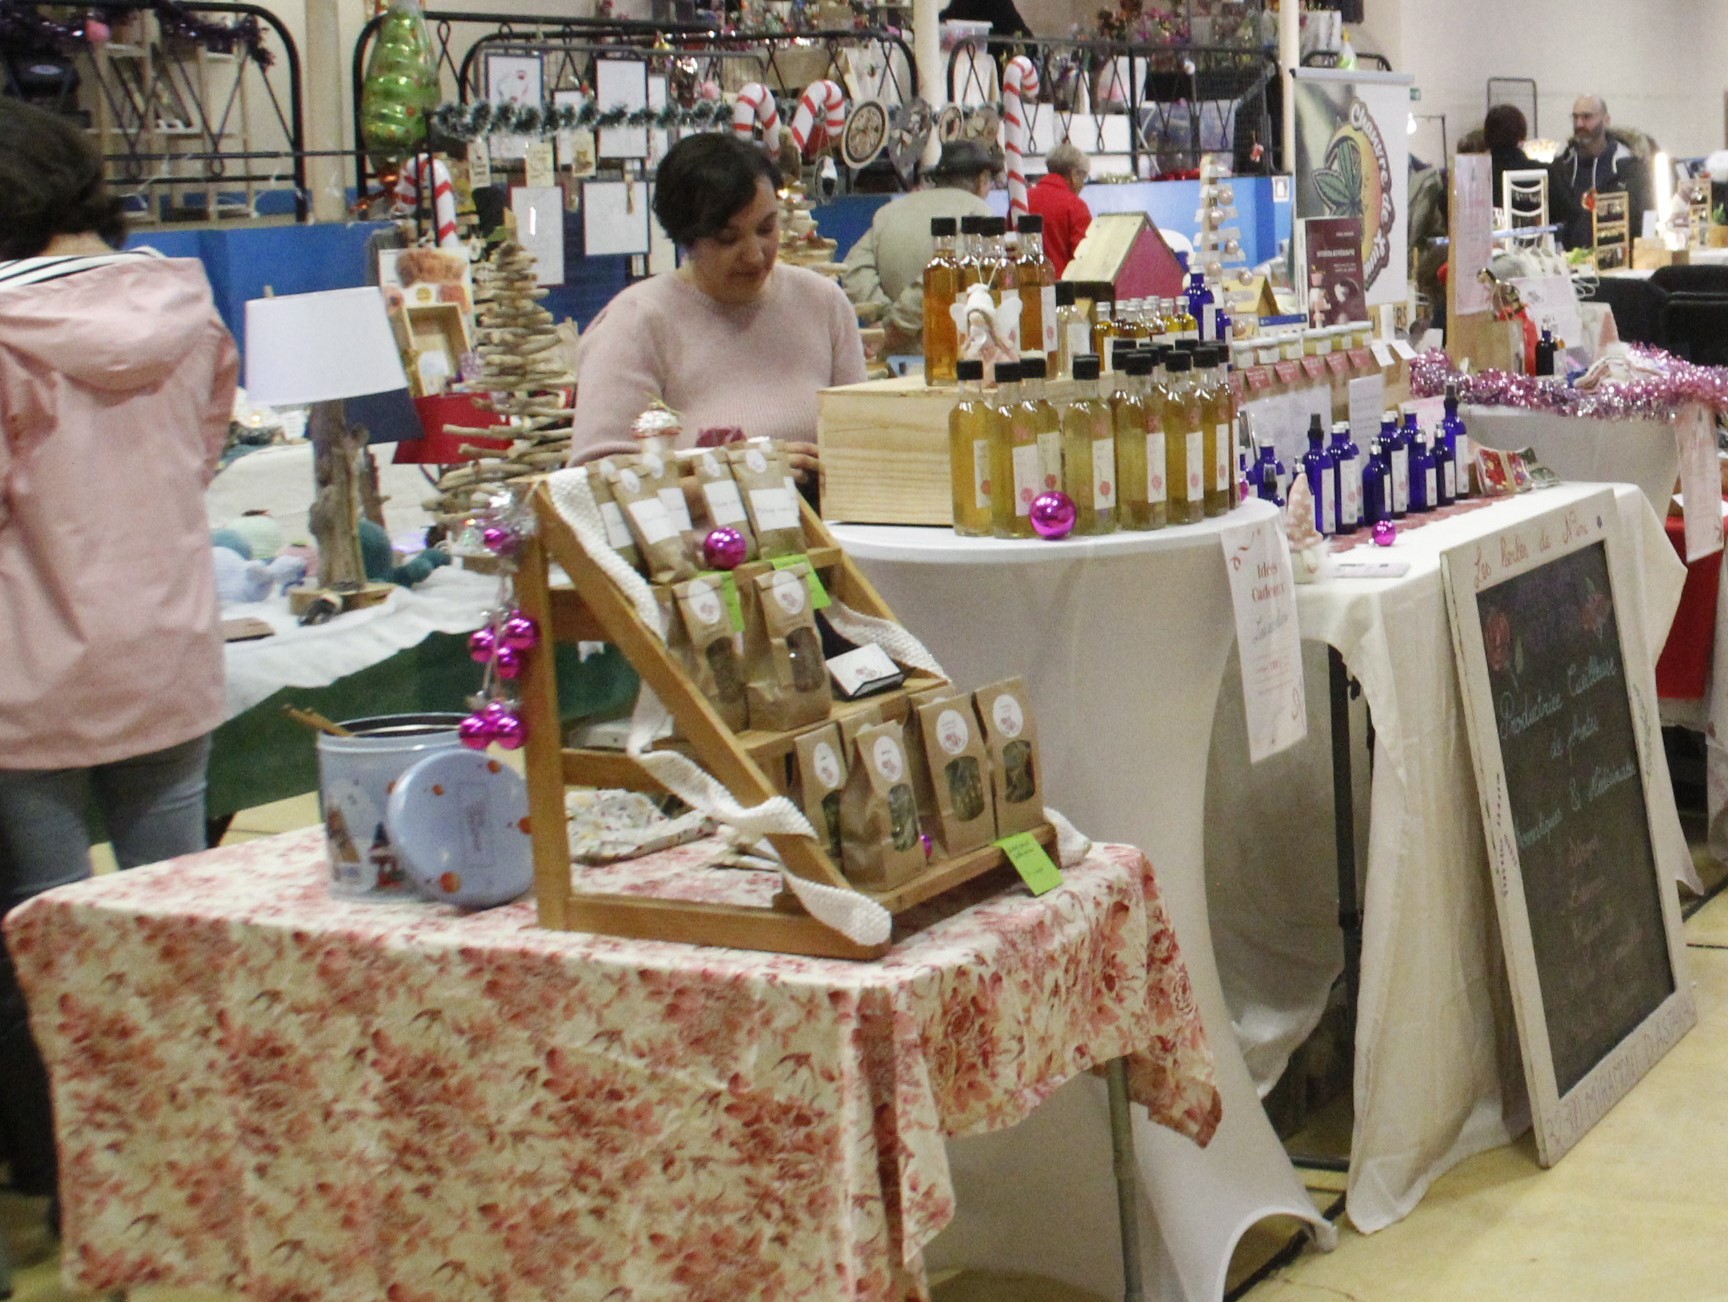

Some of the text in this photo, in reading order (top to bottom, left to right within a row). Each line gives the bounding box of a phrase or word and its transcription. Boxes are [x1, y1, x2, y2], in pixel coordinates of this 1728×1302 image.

[1350, 101, 1390, 185] Chanvre
[1381, 193, 1392, 227] de
[1500, 688, 1564, 740] Productrice
